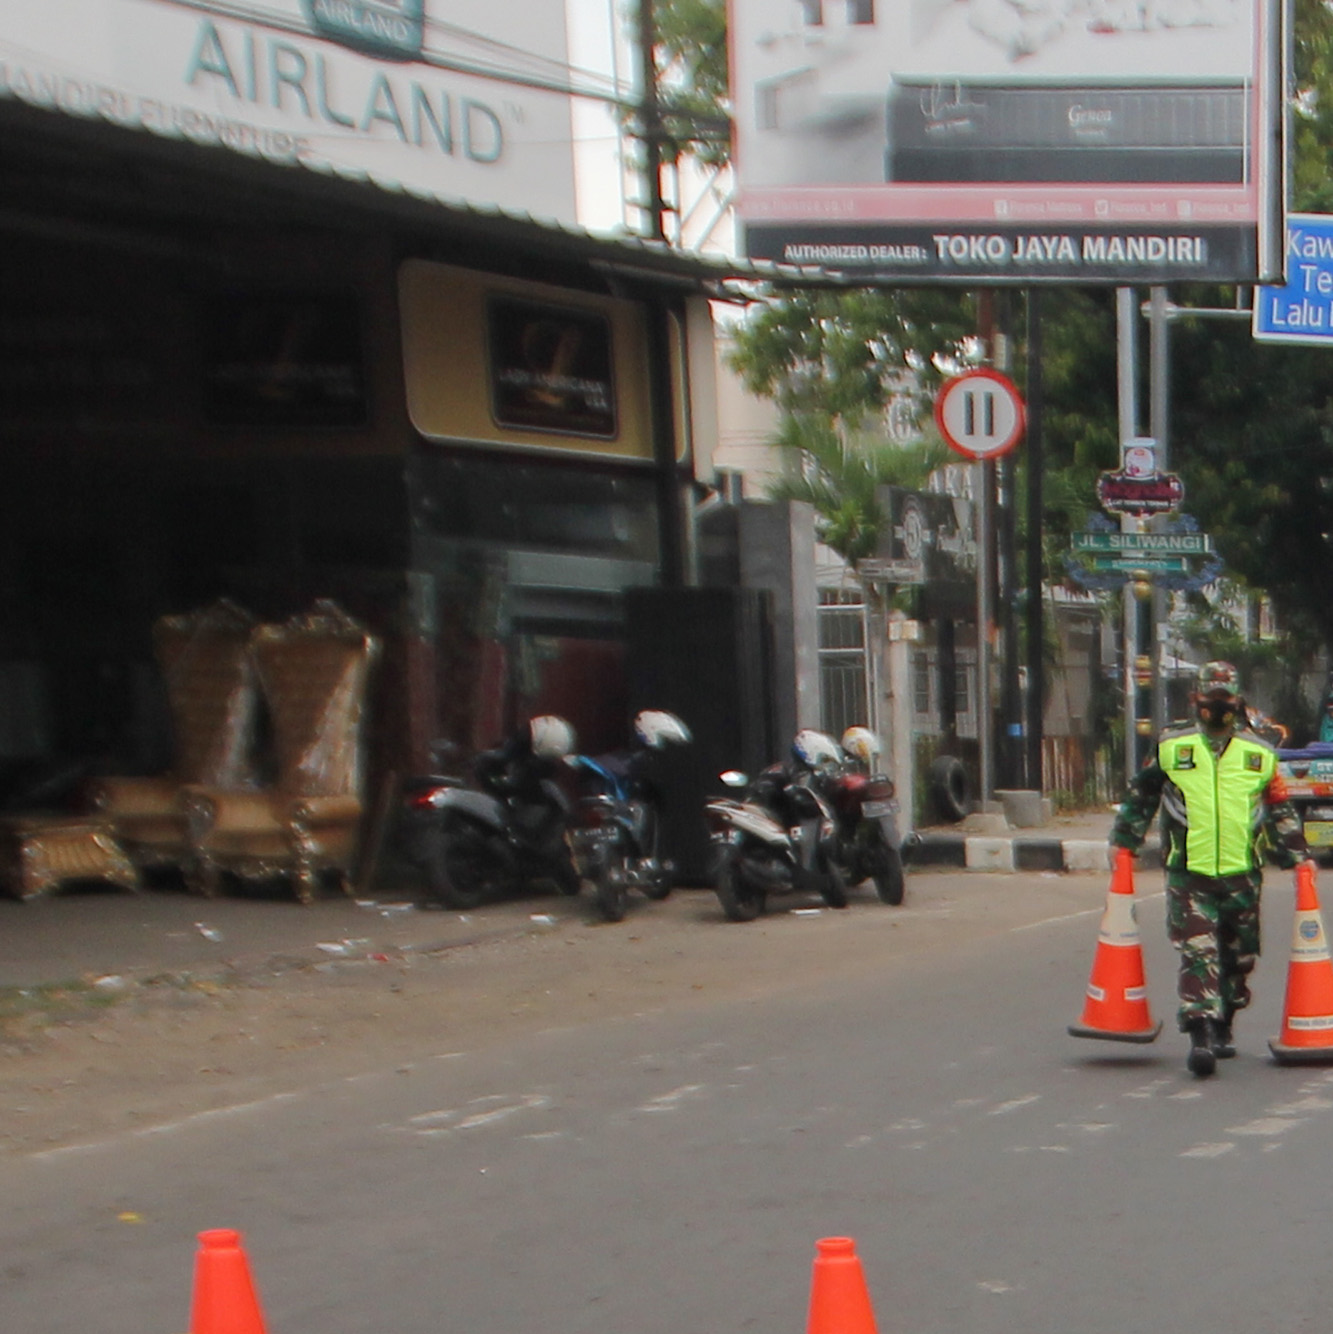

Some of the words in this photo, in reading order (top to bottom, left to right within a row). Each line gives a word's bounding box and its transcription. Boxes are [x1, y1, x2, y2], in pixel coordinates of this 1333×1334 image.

[314, 0, 410, 40] AIRLAND
[185, 17, 504, 165] AIRLAND
[784, 243, 869, 261] AUTHORIZED
[932, 234, 1005, 263] TOKO
[1011, 235, 1077, 263] JAYA
[1081, 235, 1203, 263] MANDIRI
[1271, 297, 1323, 326] Lalu
[1078, 536, 1103, 548] JL.
[1109, 536, 1200, 549] SILIWANGI
